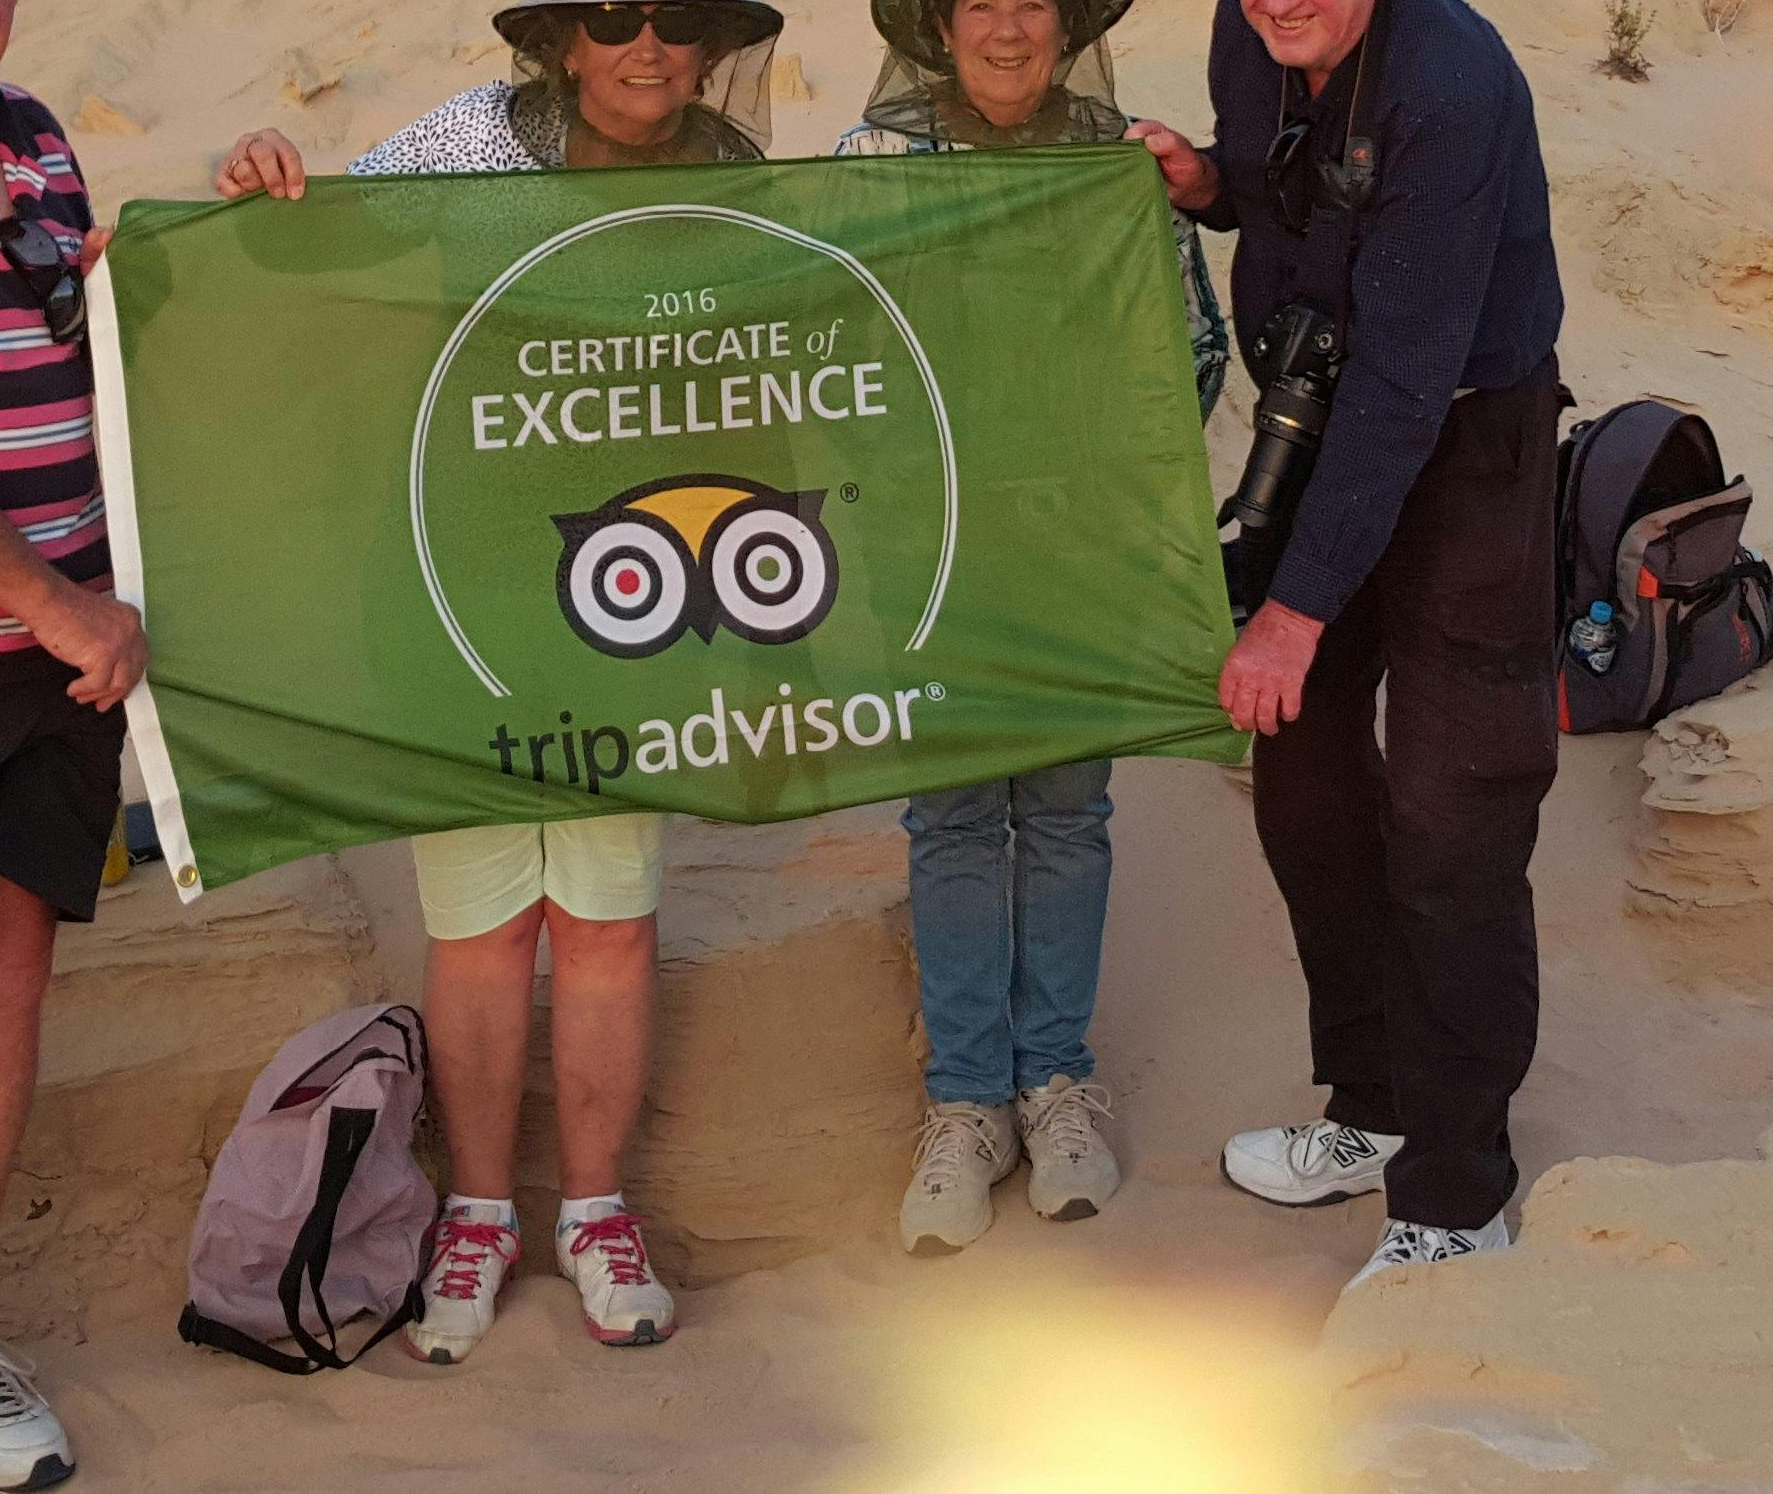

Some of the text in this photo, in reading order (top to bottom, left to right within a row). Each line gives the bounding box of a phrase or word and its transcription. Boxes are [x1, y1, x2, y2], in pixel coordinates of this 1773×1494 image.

[643, 287, 717, 318] 2016
[517, 318, 844, 377] CERTIFICATE of
[470, 361, 888, 451] EXCELLENCE
